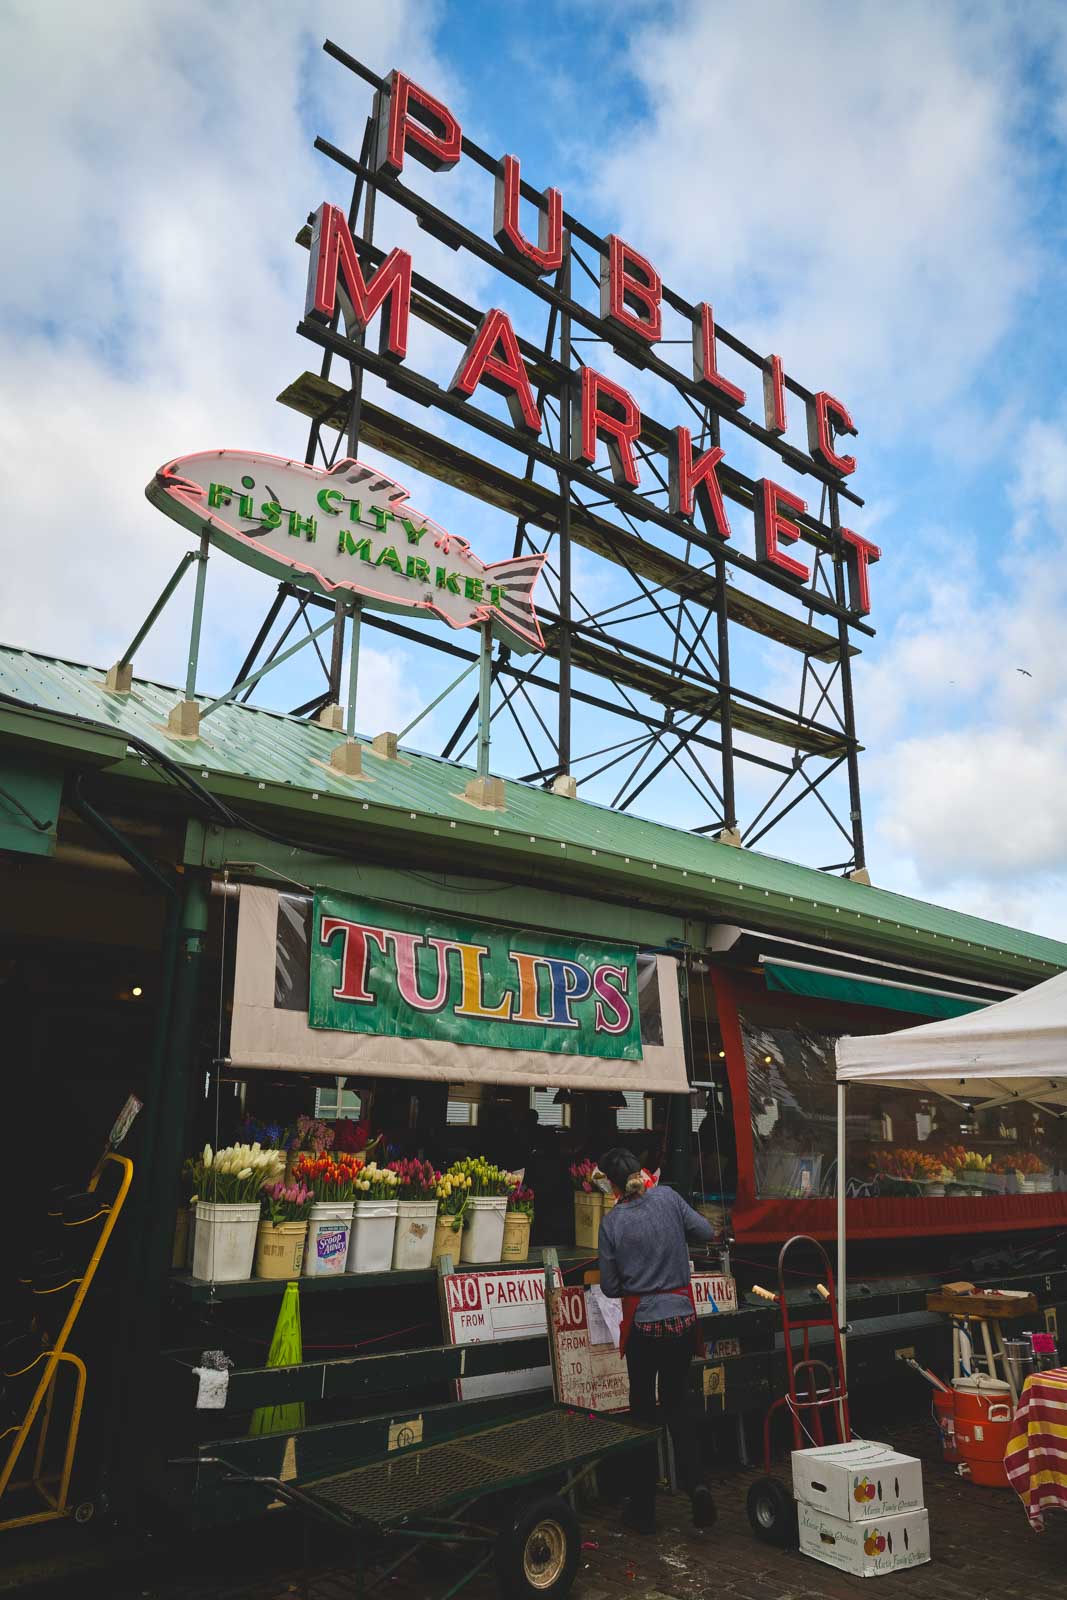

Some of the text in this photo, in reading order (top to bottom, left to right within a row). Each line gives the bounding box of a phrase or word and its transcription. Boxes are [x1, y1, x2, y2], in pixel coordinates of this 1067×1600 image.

[376, 69, 857, 476] PUBLIC
[304, 201, 880, 616] MARKET
[317, 488, 427, 546] CITY
[207, 482, 508, 608] FISH MARKET
[320, 914, 630, 1034] TULIPS
[448, 1278, 545, 1308] NO PARKIN
[695, 1281, 732, 1302] RKING
[460, 1314, 485, 1327] FROM
[558, 1294, 583, 1326] NO
[561, 1338, 586, 1349] FROM
[570, 1362, 582, 1375] TO
